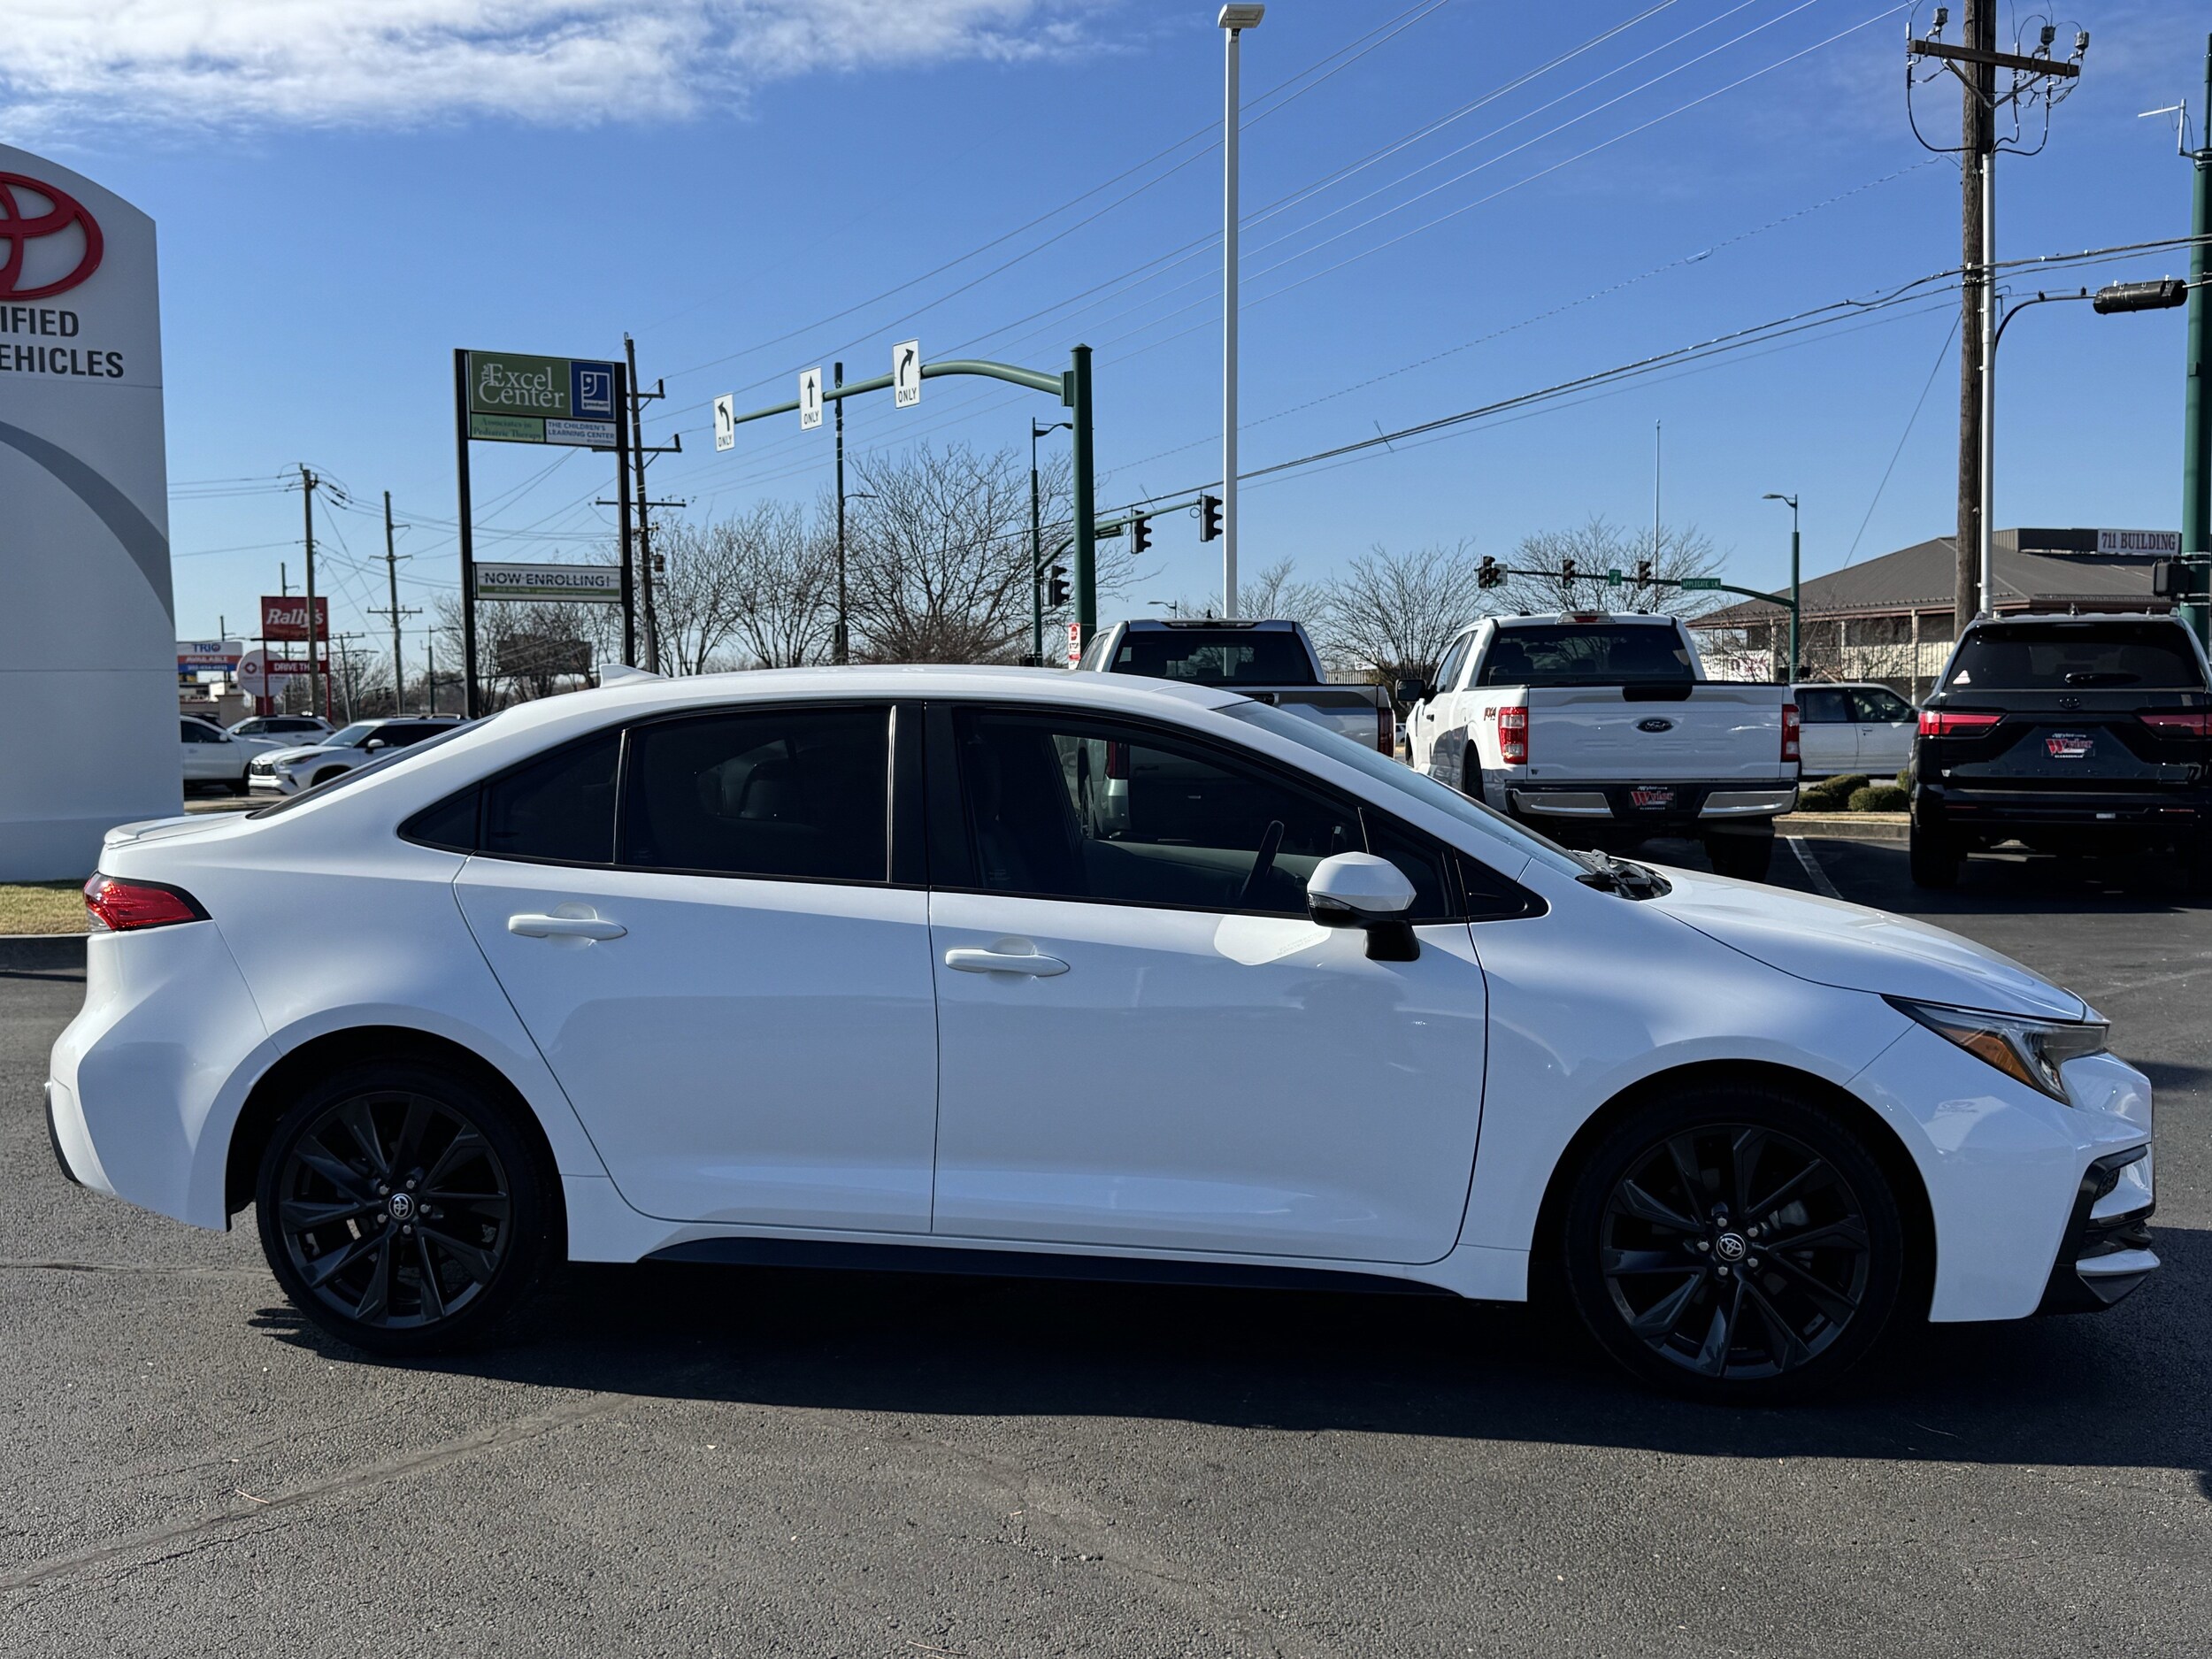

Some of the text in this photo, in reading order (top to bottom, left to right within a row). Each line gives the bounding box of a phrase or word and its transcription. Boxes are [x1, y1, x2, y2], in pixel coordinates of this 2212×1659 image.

[488, 363, 554, 391] Excel
[479, 380, 565, 408] Center
[898, 387, 918, 403] ONLY
[803, 412, 818, 425] ONLY
[548, 429, 586, 438] LEARNING
[564, 422, 606, 431] CHILDREN'S
[718, 434, 733, 448] ONLY
[2101, 533, 2176, 550] 711 BUILDING
[485, 572, 611, 587] NOW ENROLLING!
[192, 643, 221, 653] TRIO
[274, 662, 298, 672] DRIVE
